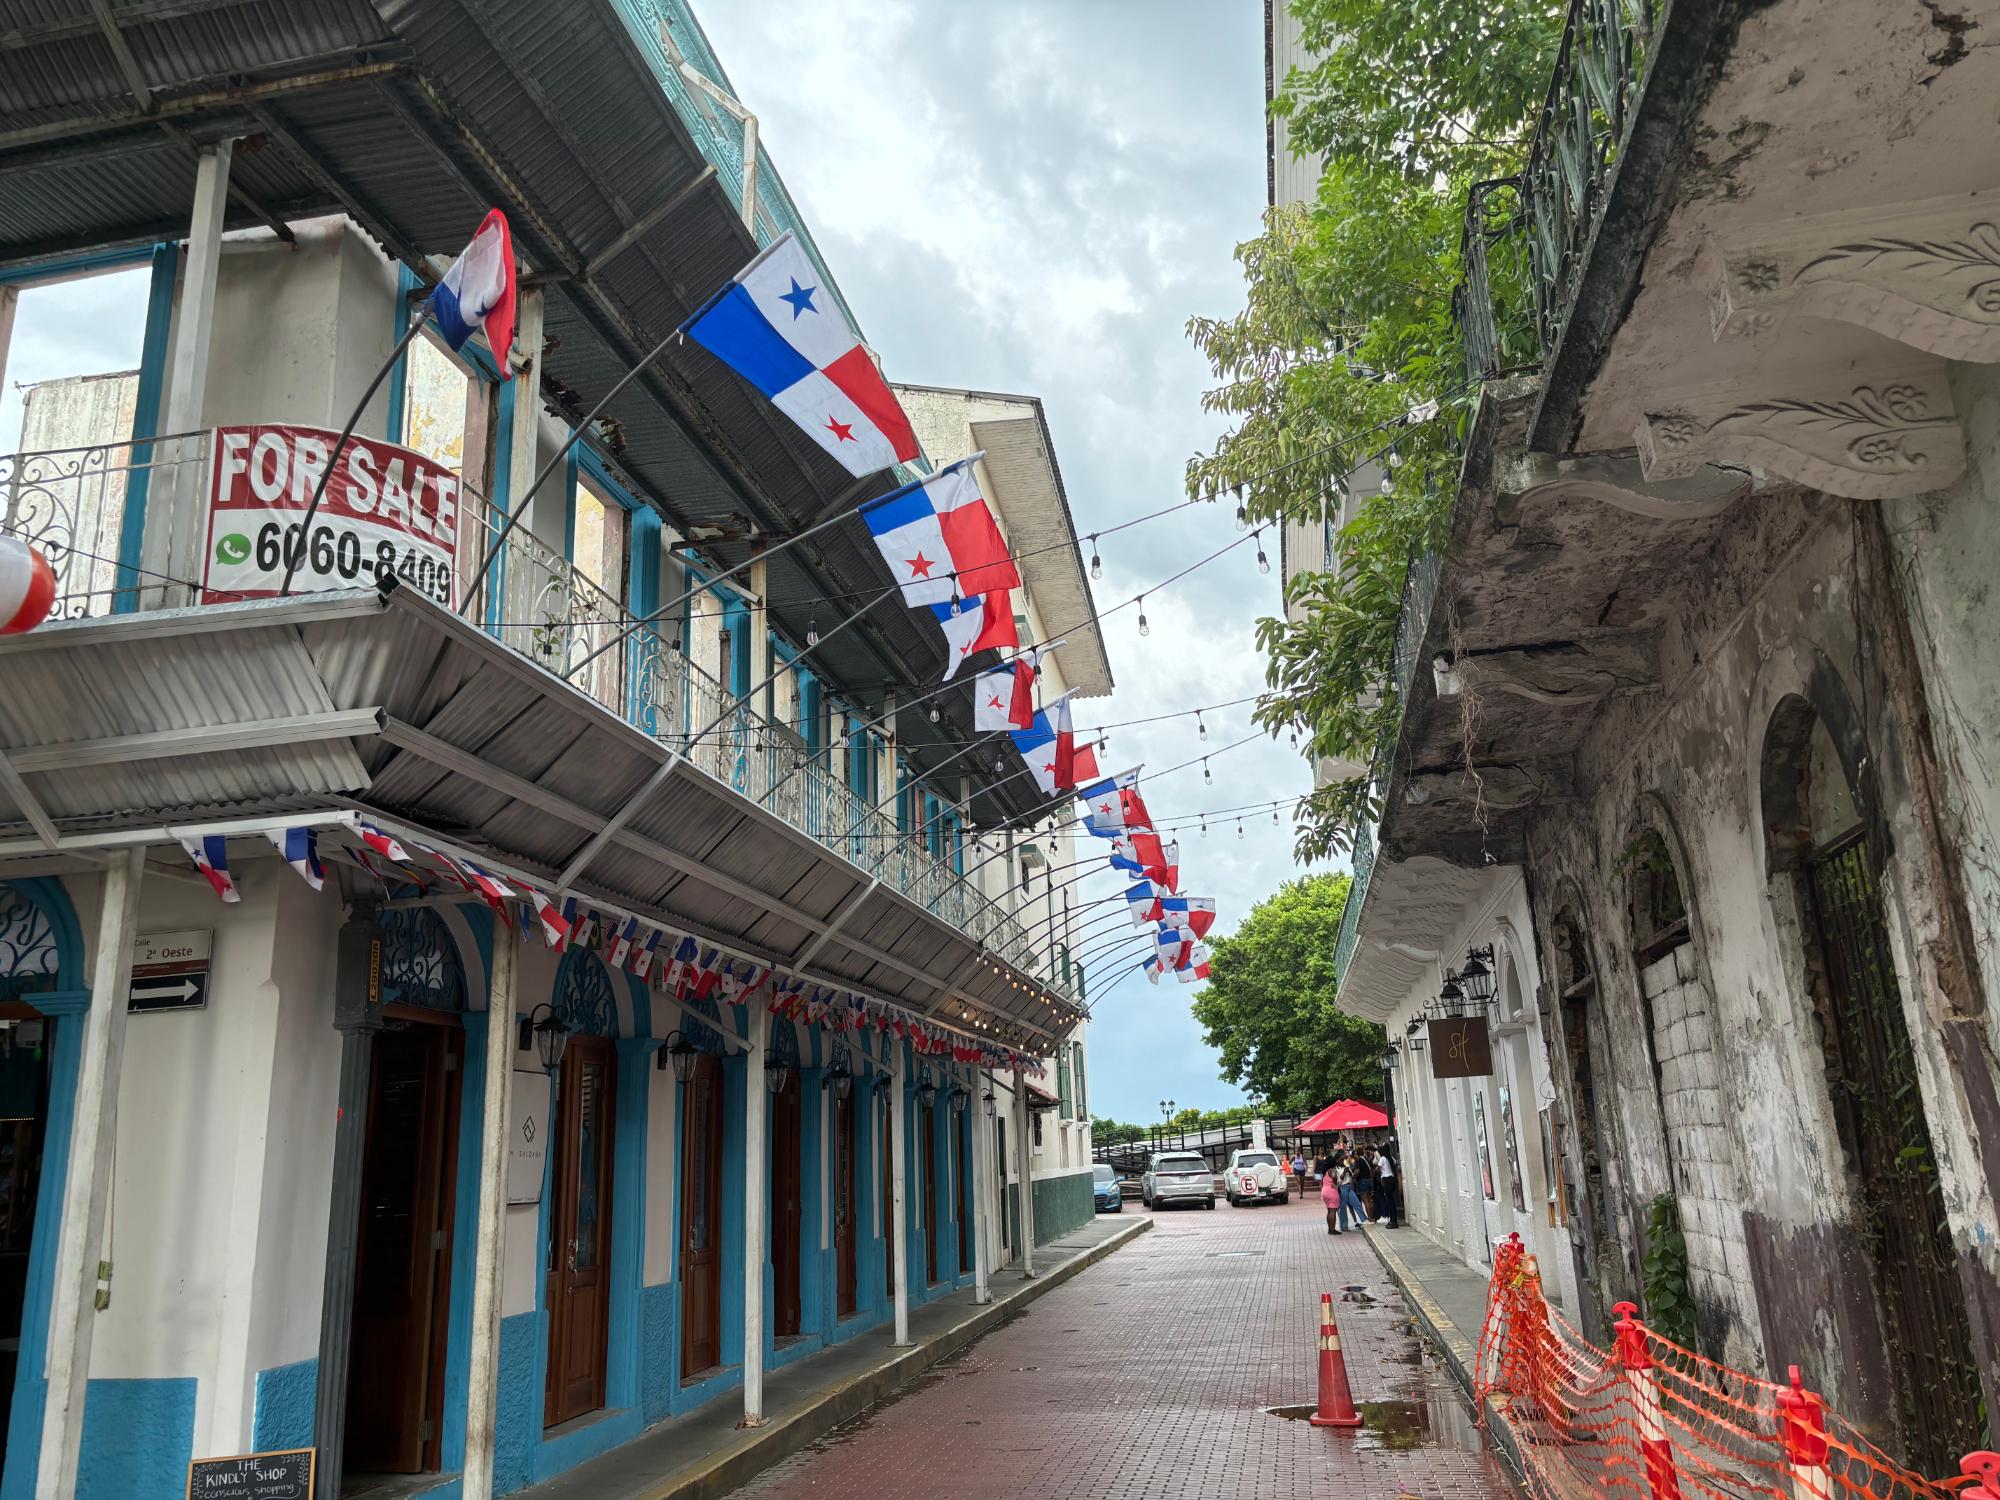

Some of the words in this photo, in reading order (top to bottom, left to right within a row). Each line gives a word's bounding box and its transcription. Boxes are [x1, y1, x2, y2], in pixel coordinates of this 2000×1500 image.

[219, 432, 328, 505] FOR
[346, 445, 457, 546] SALE
[256, 522, 451, 604] 6060-8409
[162, 947, 193, 958] Oeste
[237, 1458, 262, 1472] THE
[206, 1472, 248, 1488] KINDLY
[255, 1468, 287, 1482] SHOP
